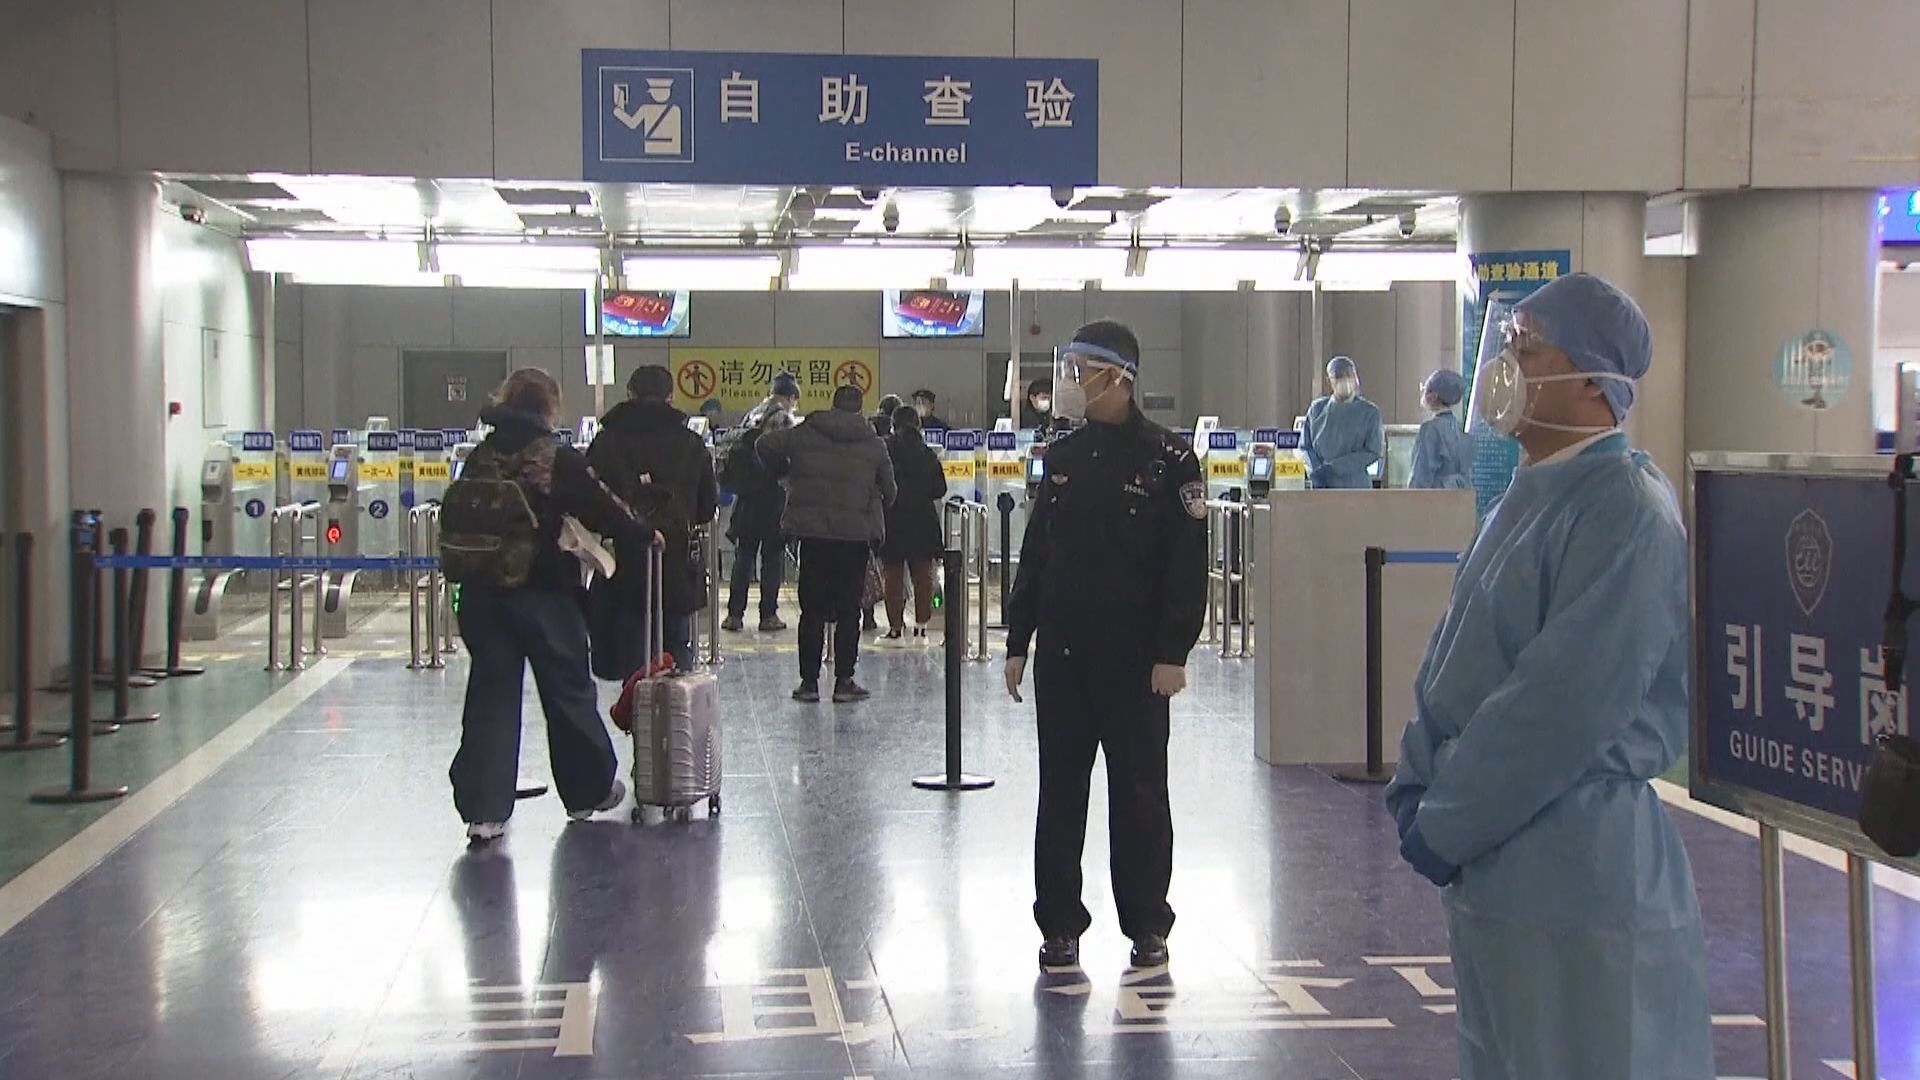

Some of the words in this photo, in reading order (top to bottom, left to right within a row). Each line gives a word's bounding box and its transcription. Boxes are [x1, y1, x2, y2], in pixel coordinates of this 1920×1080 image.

[719, 70, 1075, 128] 自助查验
[845, 142, 967, 164] E-channel
[720, 388, 761, 398] Please
[807, 387, 835, 399] stay
[238, 465, 270, 477] 一次一人
[363, 465, 393, 477] 一次一人
[1729, 729, 1796, 774] GUIDE
